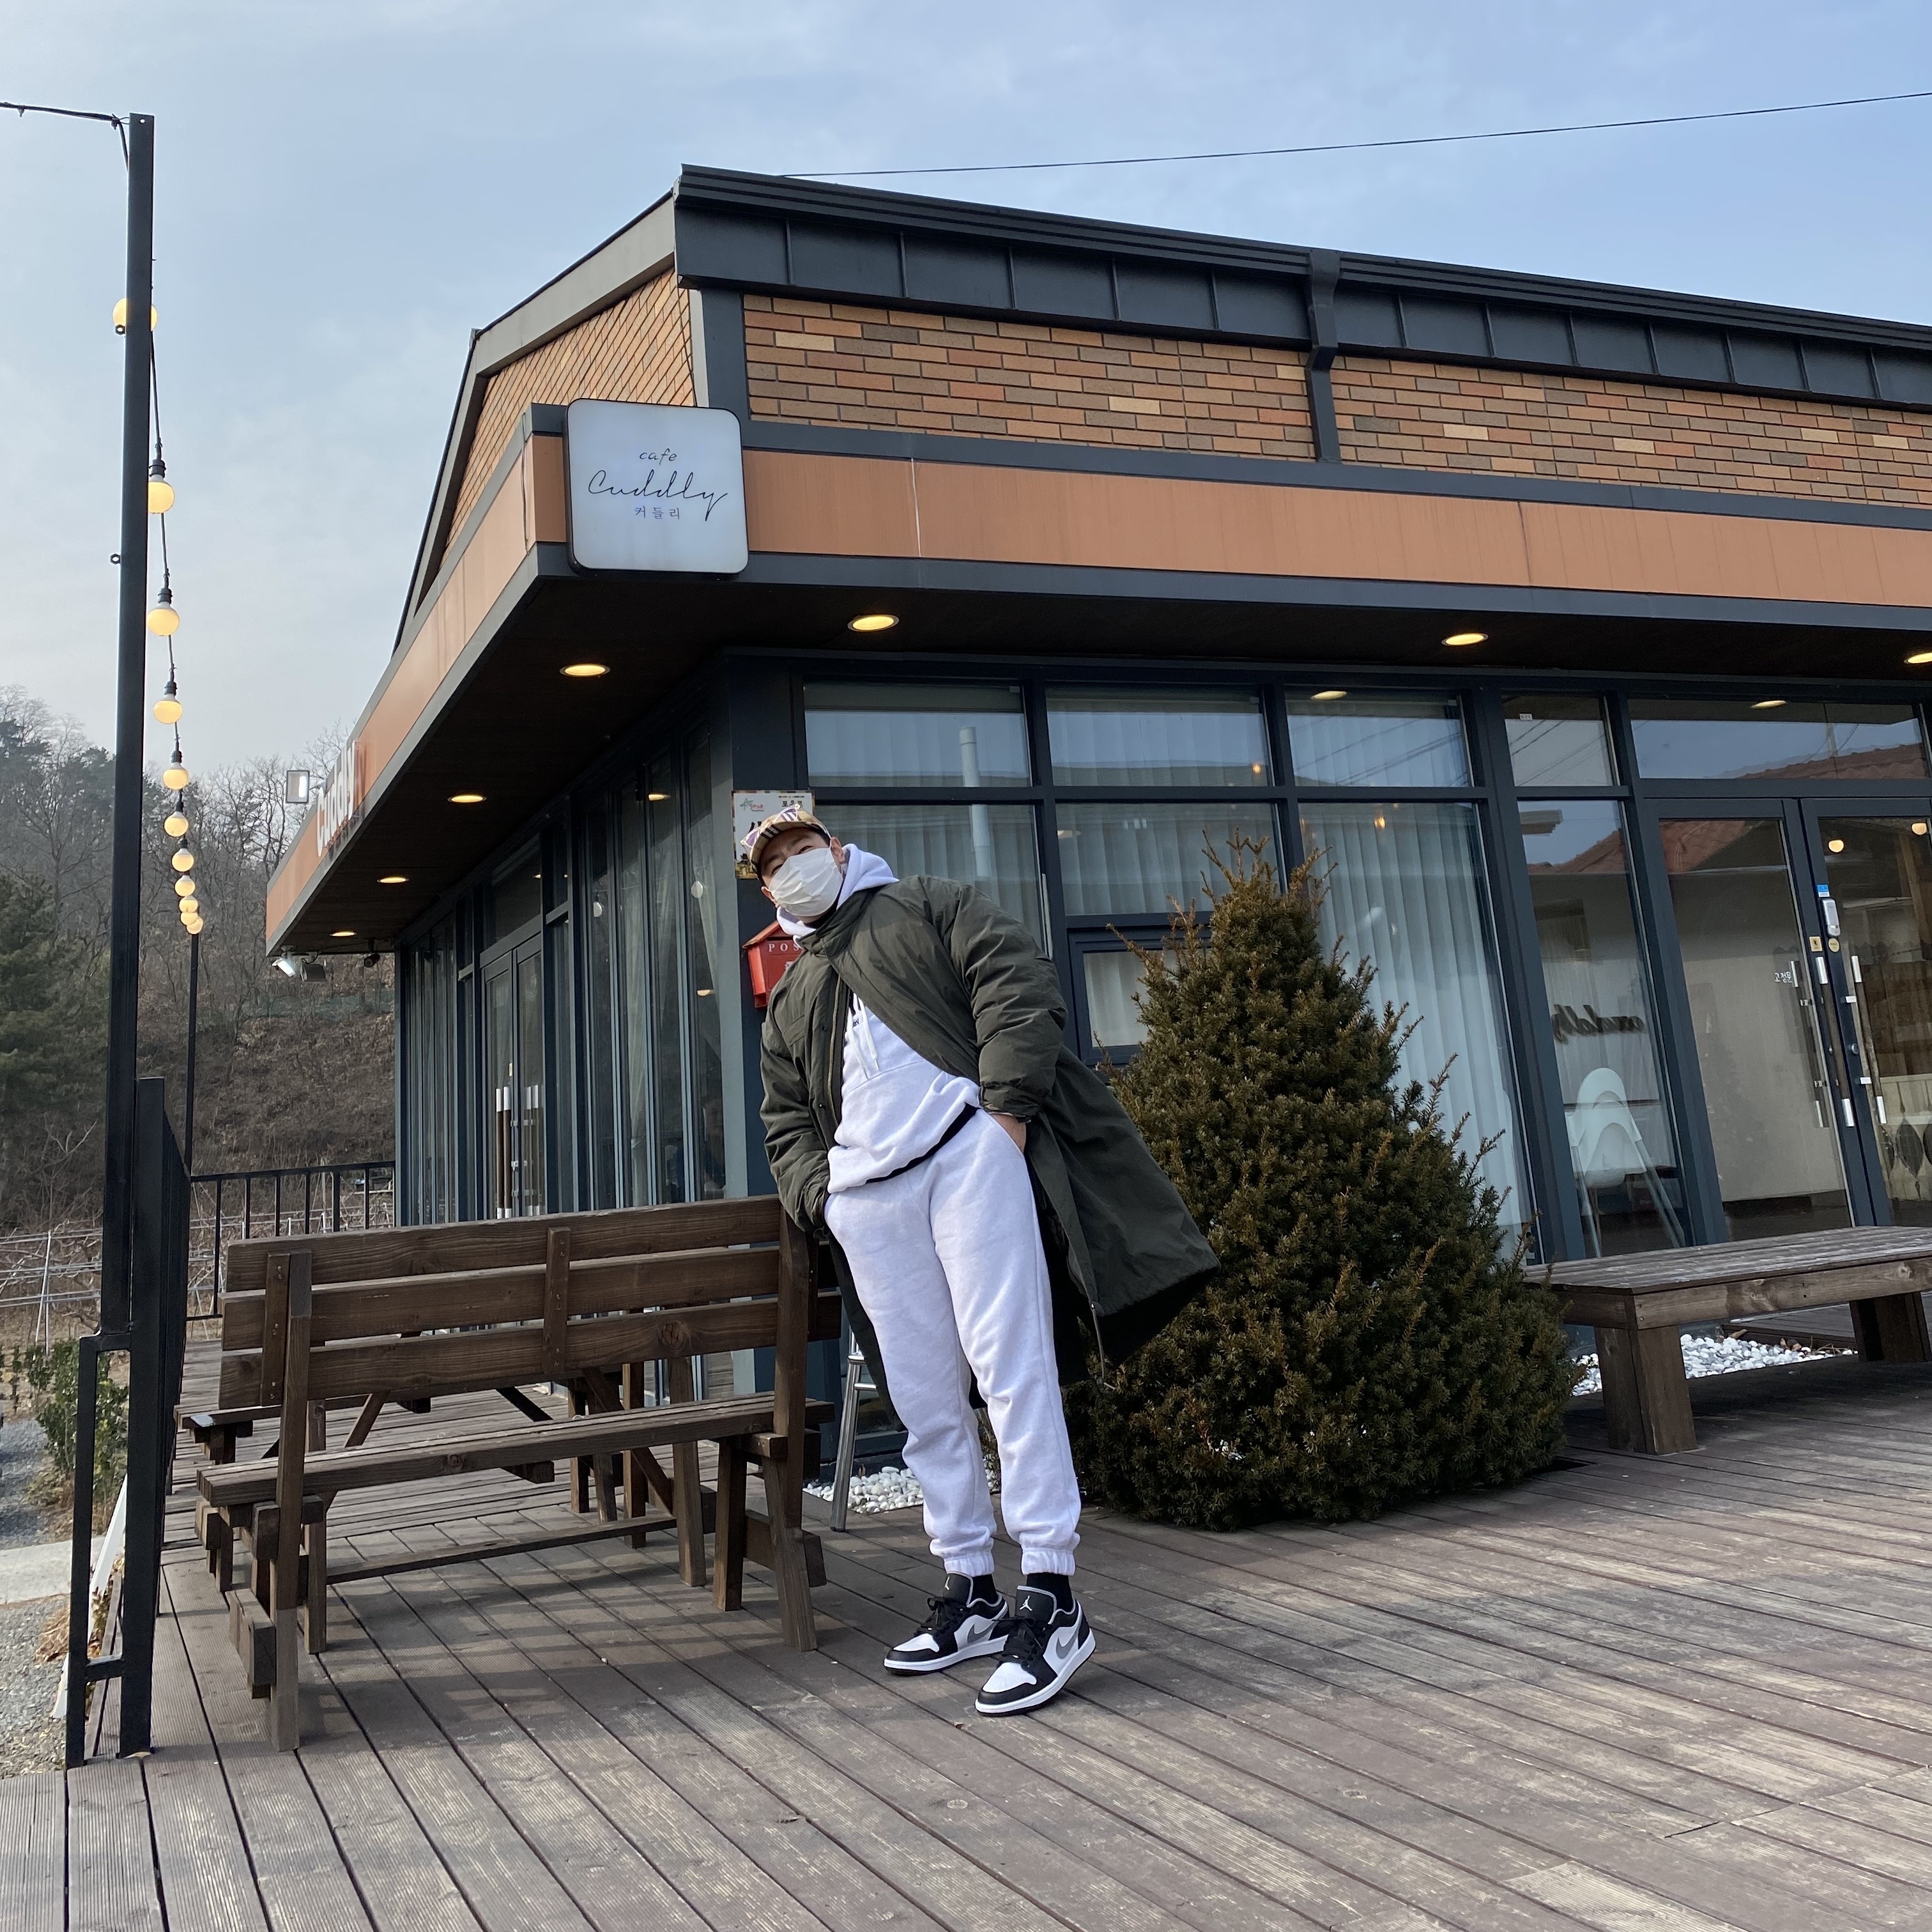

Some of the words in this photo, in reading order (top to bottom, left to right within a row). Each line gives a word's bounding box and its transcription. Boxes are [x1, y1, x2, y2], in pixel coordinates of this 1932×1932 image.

[639, 448, 677, 466] cafe
[588, 469, 728, 522] Cuddly
[634, 505, 680, 521] 커들리
